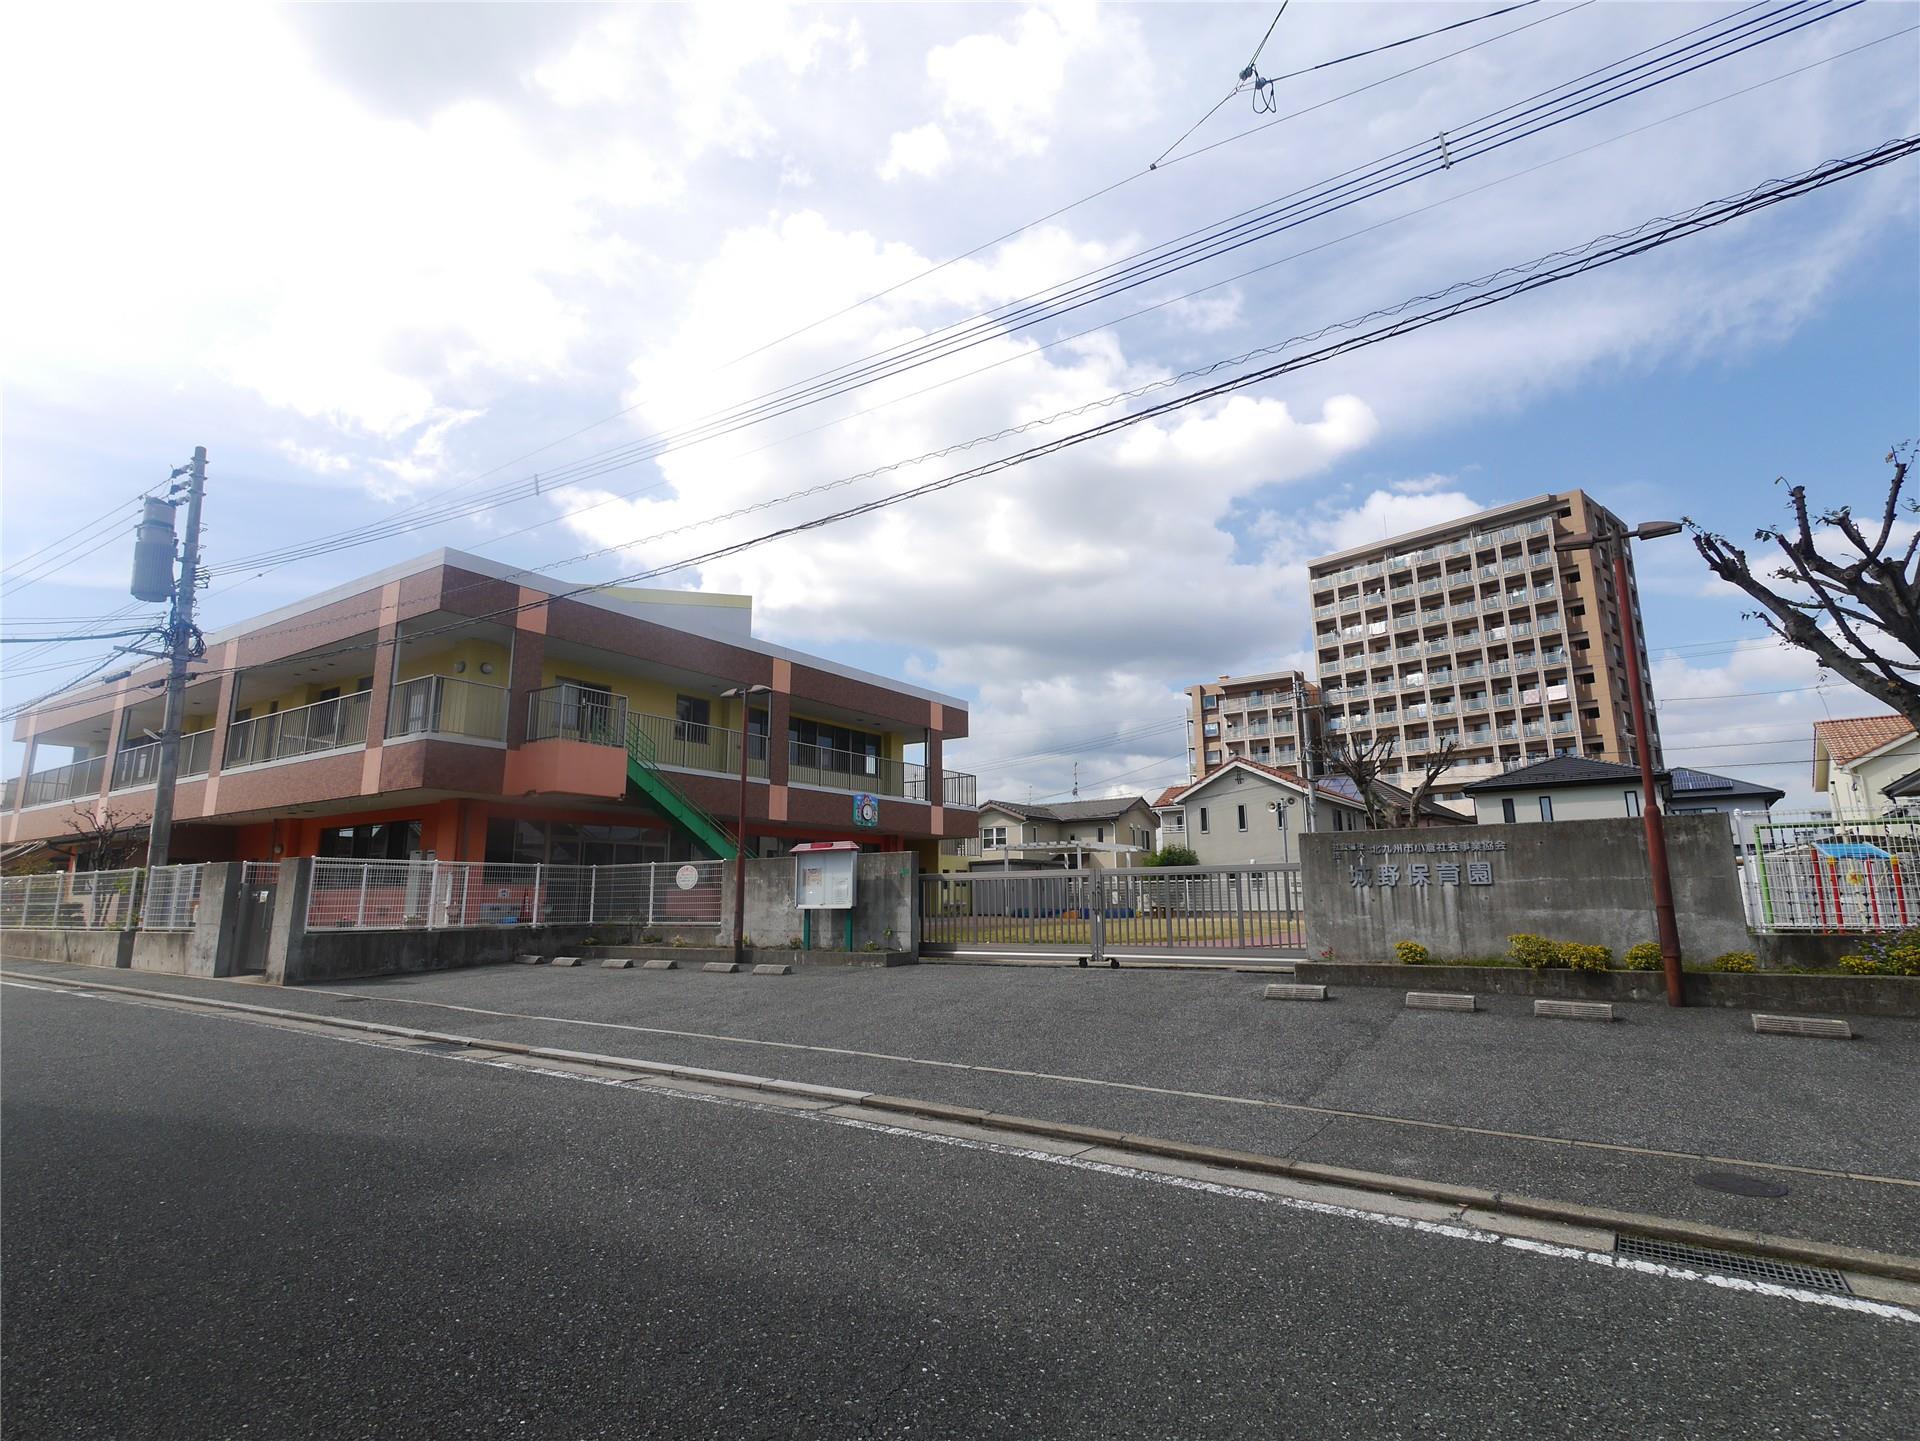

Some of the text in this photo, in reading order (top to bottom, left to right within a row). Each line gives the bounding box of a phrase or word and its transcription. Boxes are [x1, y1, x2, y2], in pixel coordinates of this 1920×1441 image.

[1350, 862, 1493, 887] 城野保育園
